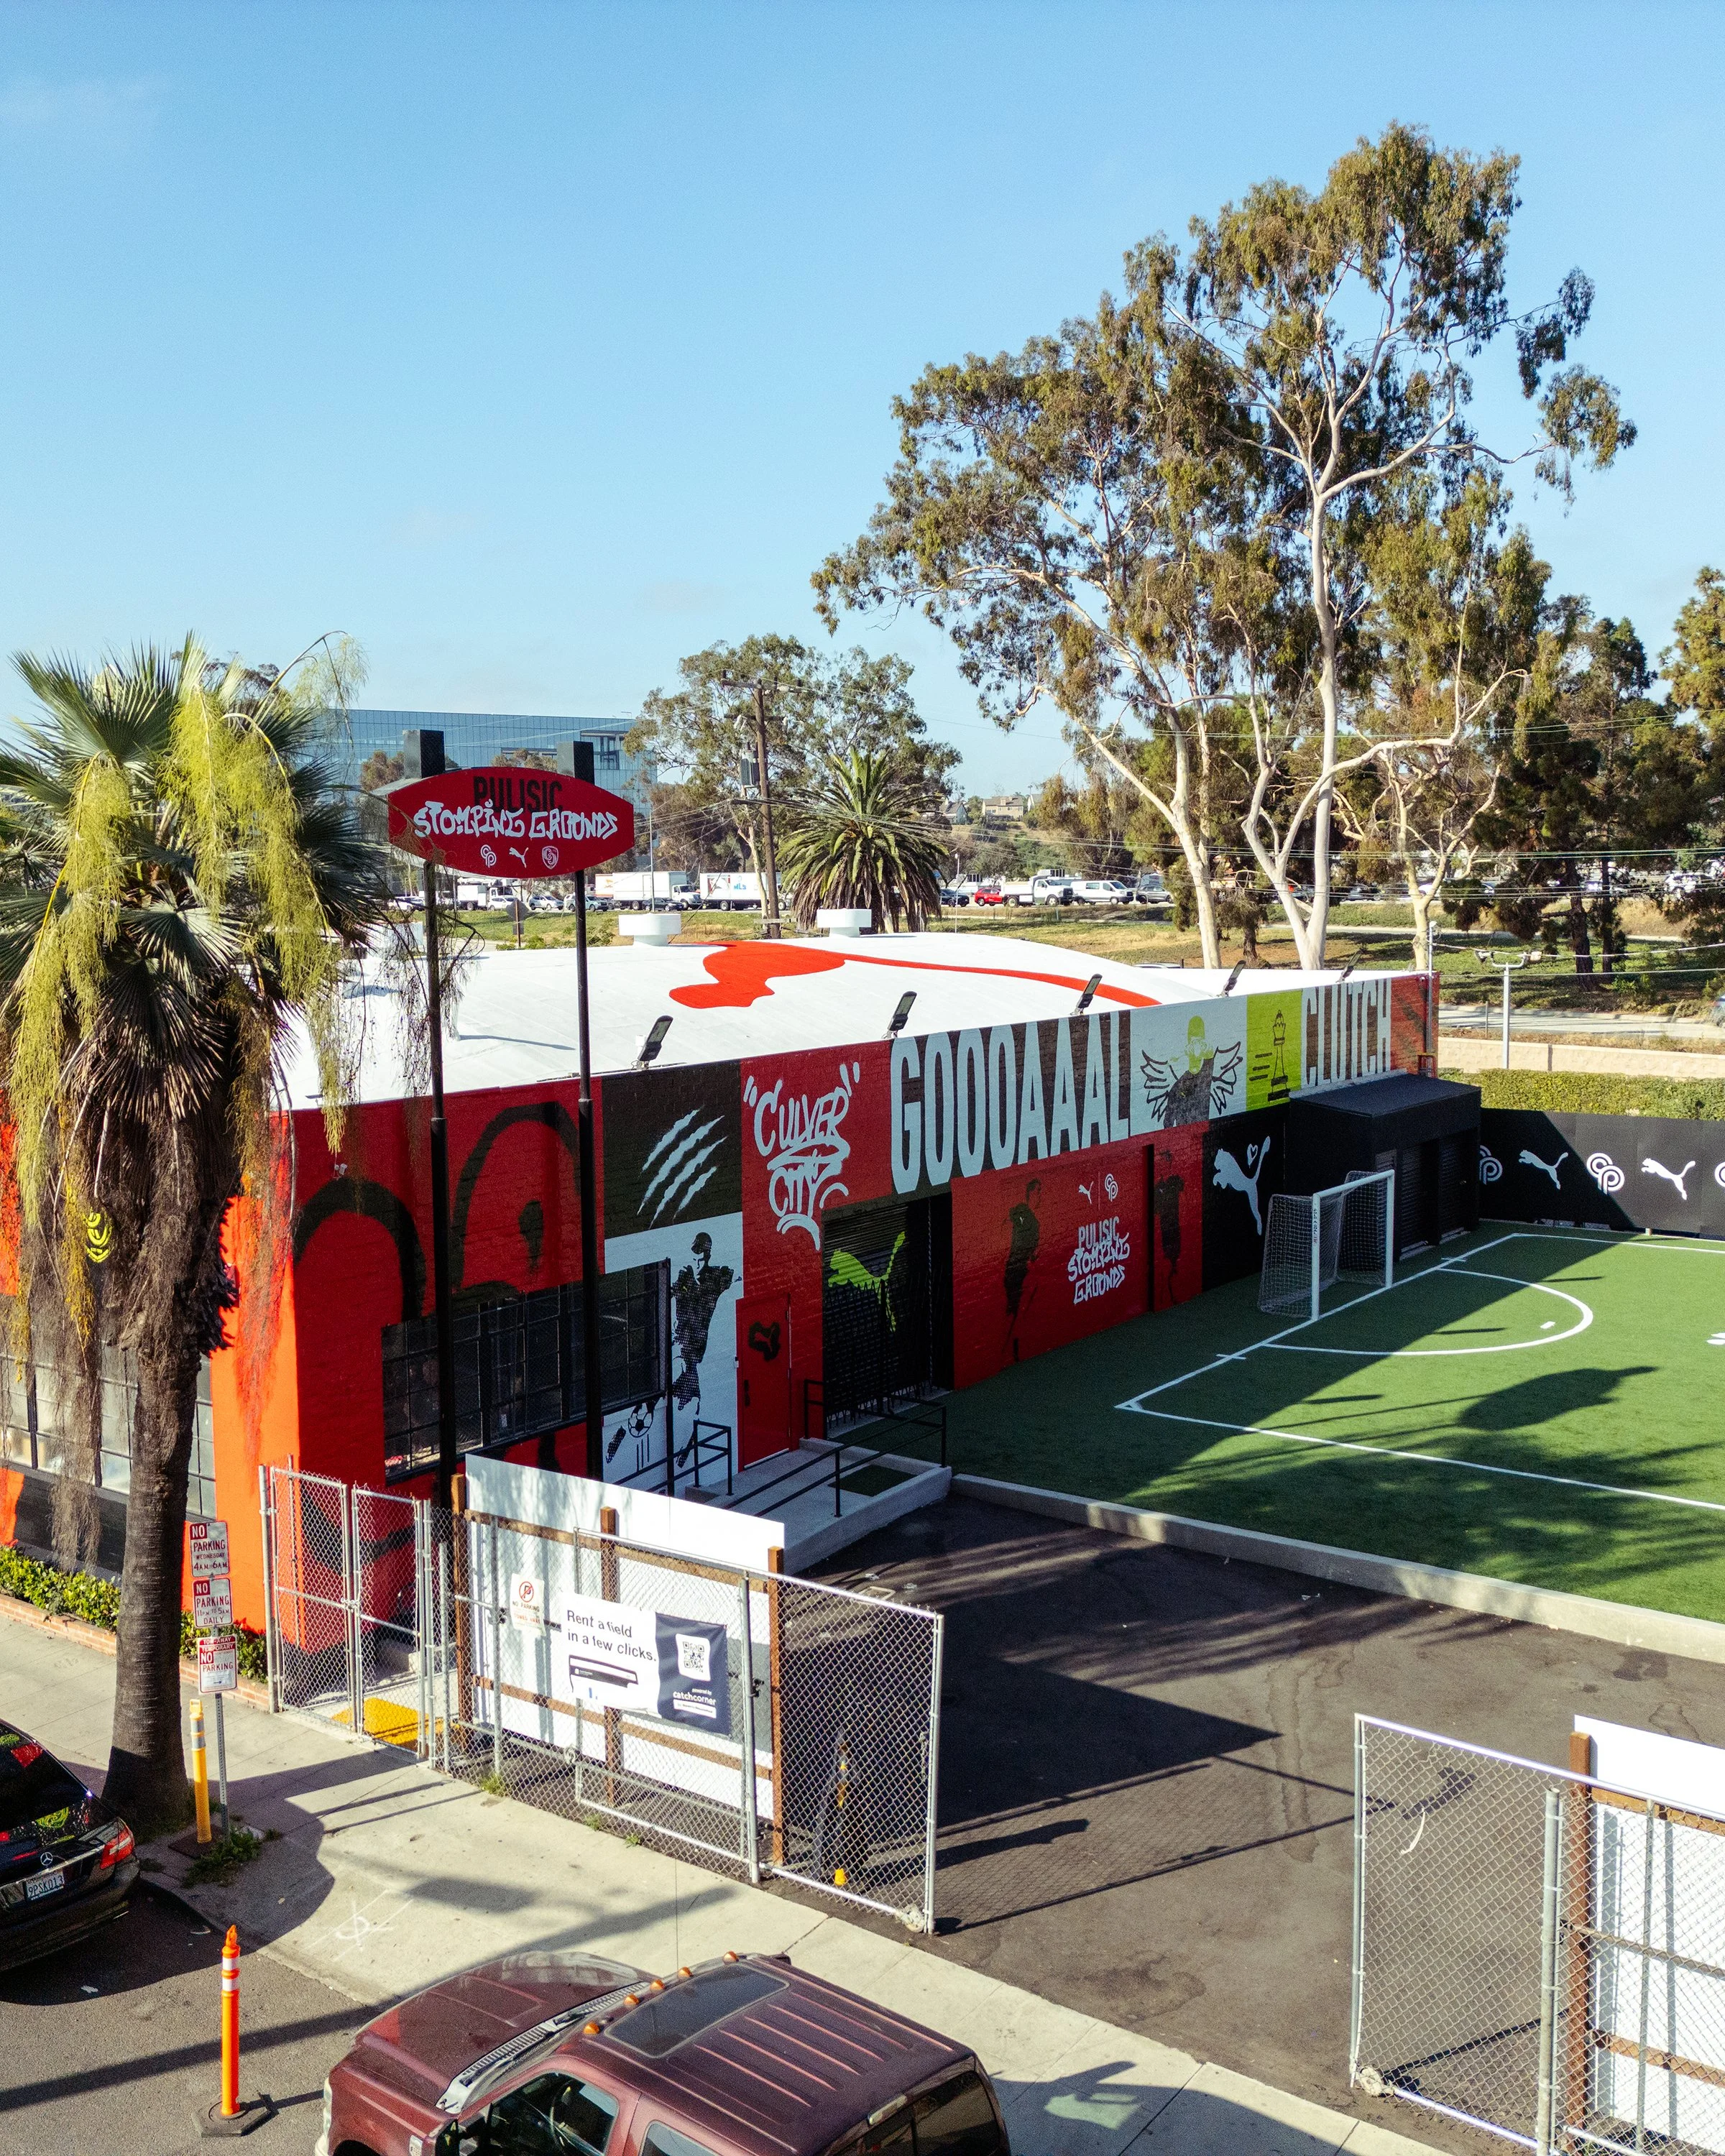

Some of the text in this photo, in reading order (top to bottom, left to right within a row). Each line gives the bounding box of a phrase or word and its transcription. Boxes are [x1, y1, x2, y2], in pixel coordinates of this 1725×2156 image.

[474, 776, 564, 814] PULISIC
[528, 808, 618, 840] GROUNDS
[1302, 977, 1392, 1087] CLUTCH
[891, 1009, 1129, 1194] GOOOAAAL
[1078, 1216, 1120, 1249] PULISIC
[192, 1524, 205, 1538] NO
[193, 1539, 226, 1552] PARKING
[196, 1583, 208, 1594] NO
[196, 1595, 229, 1608] PARKING
[520, 1602, 540, 1612] PARKING
[203, 1616, 224, 1625] DAILY
[567, 1609, 632, 1639] Rent a field
[202, 1643, 234, 1652] TEMPORARY
[568, 1628, 657, 1662] in a few clicks.
[201, 1651, 213, 1664] NO
[203, 1662, 234, 1672] PARKING
[673, 1691, 717, 1705] catchcorner
